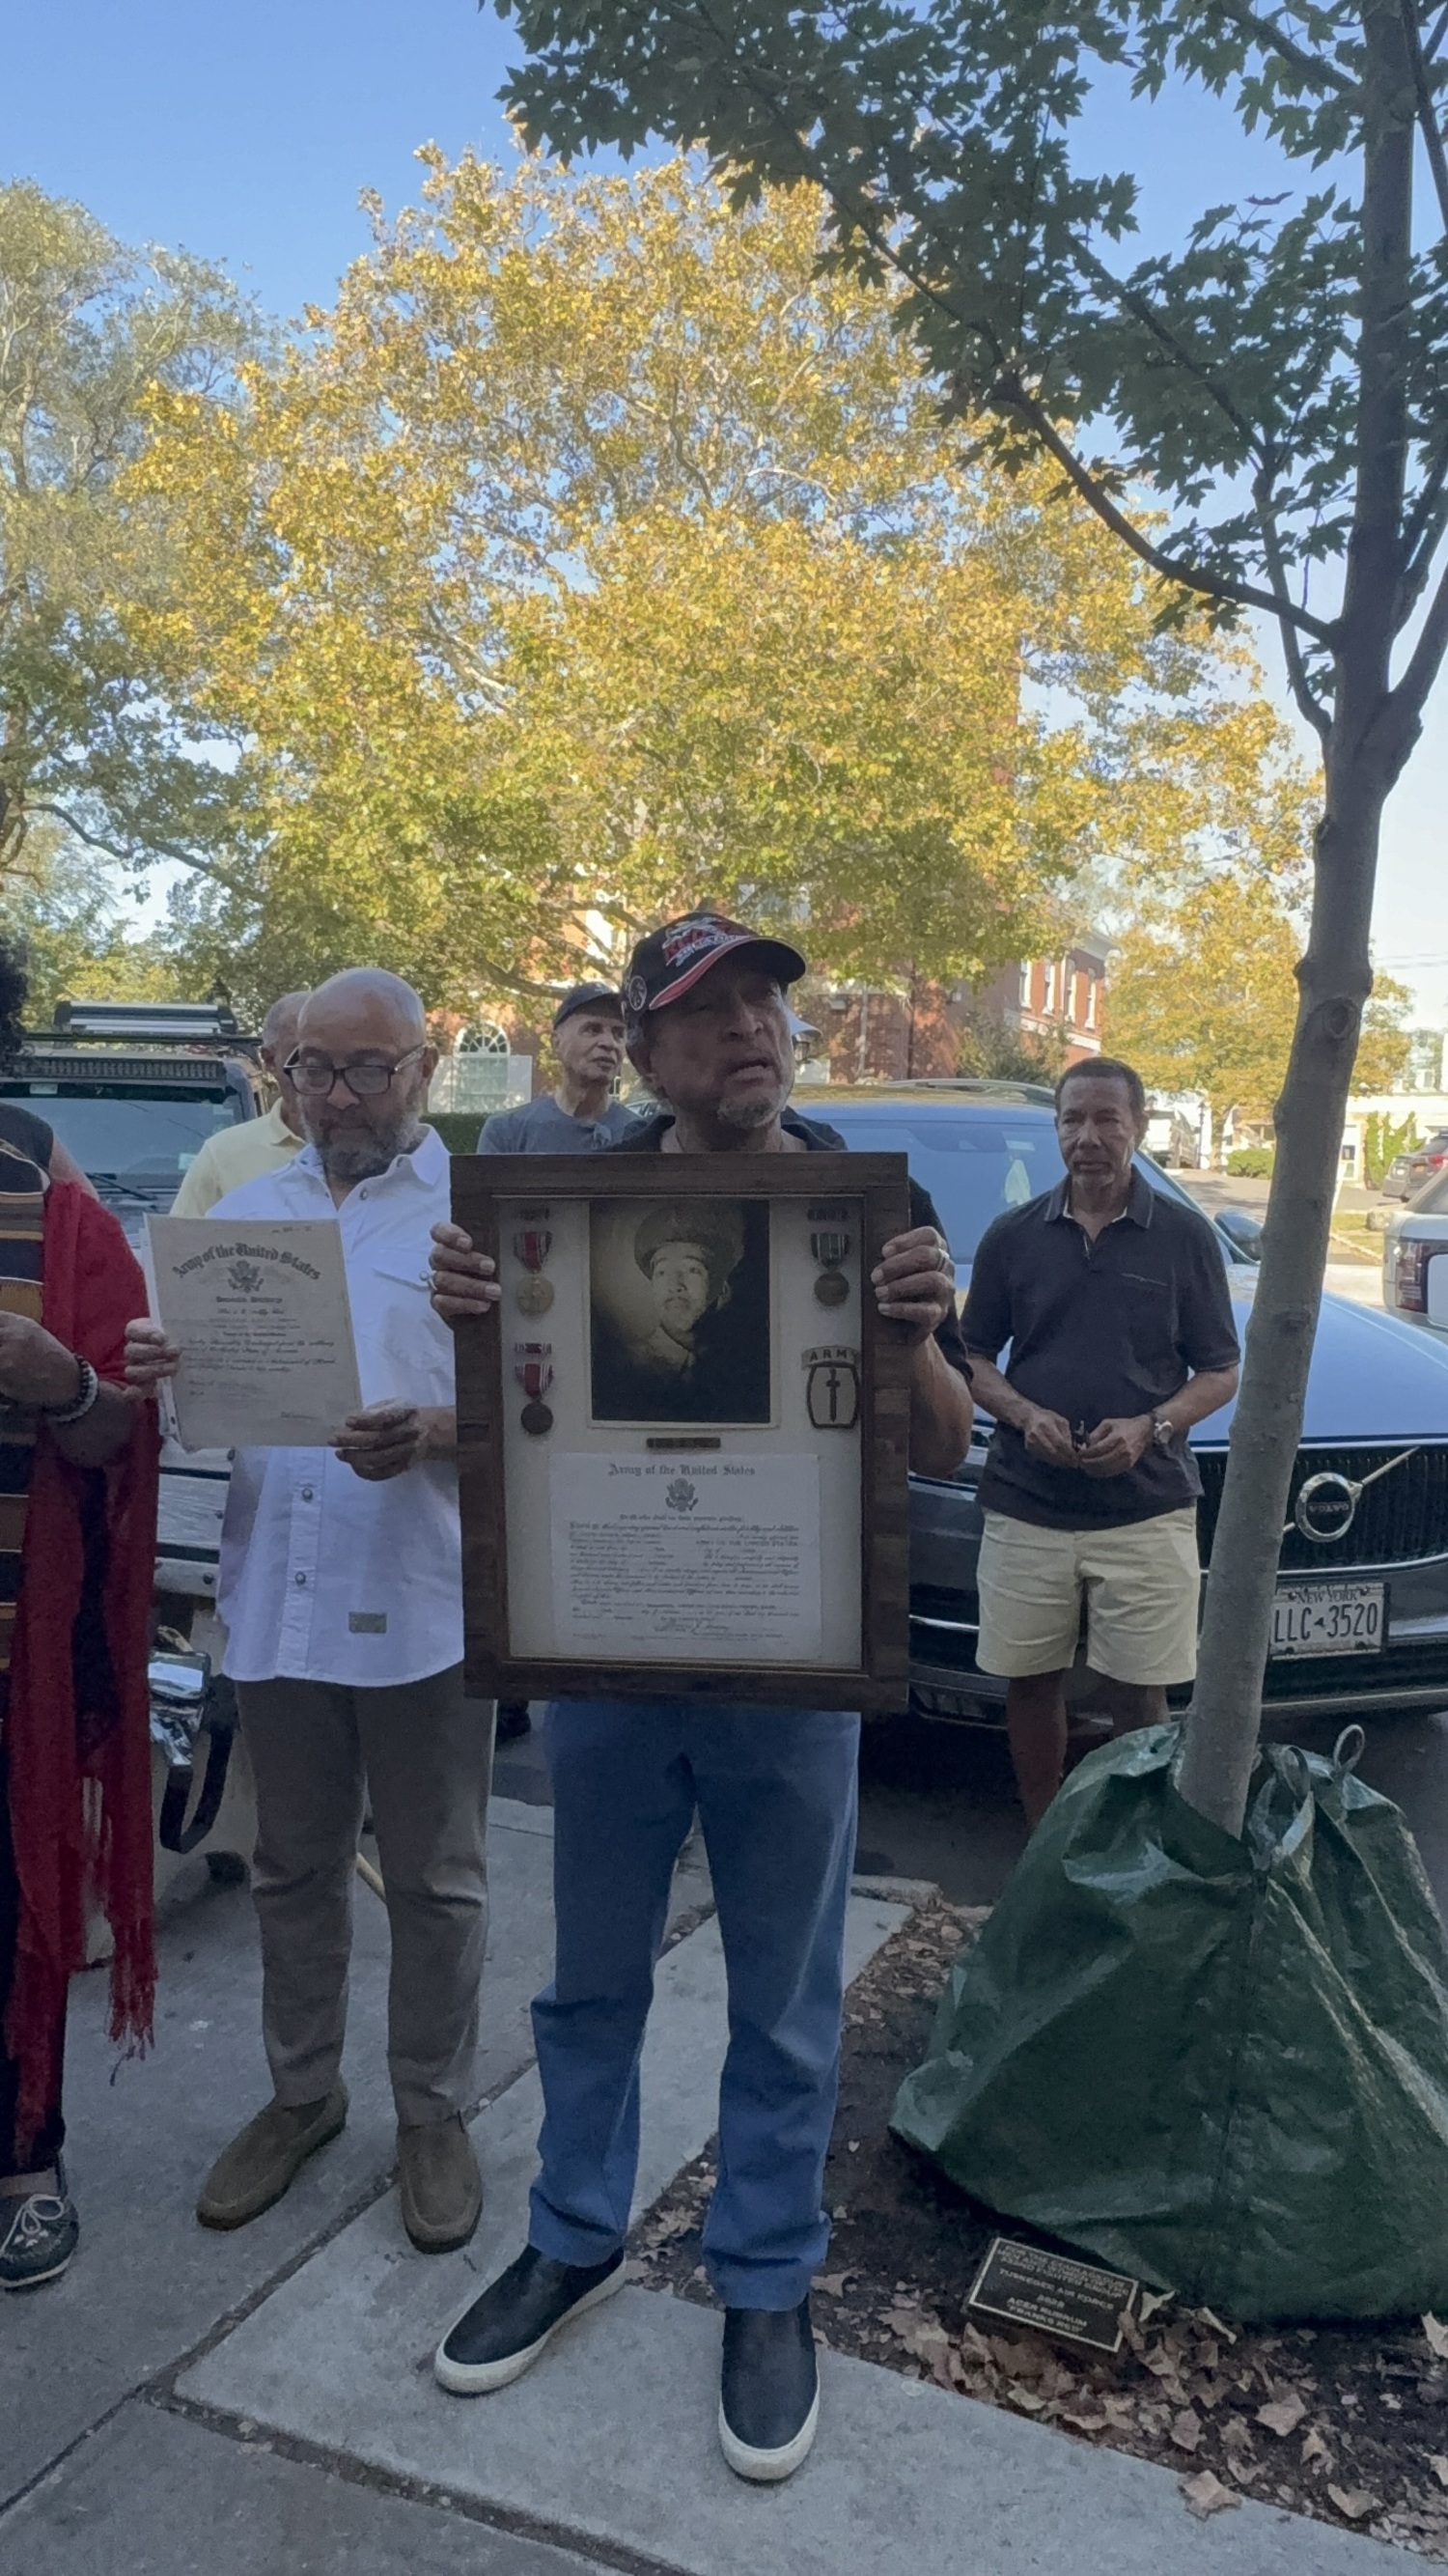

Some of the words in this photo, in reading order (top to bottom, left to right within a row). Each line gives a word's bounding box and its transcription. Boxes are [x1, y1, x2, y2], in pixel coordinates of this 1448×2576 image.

[172, 1256, 205, 1278] Army
[202, 1246, 215, 1262] of
[215, 1244, 235, 1258] the
[235, 1243, 279, 1260] United
[279, 1251, 321, 1280] States
[608, 1463, 642, 1477] Army
[646, 1464, 655, 1475] of
[659, 1464, 676, 1475] the
[680, 1463, 718, 1476] United
[723, 1464, 756, 1476] States
[1296, 1591, 1325, 1605] NEW
[1327, 1588, 1358, 1603] YORK
[1274, 1606, 1312, 1642] LLC
[1326, 1603, 1378, 1638] 3520
